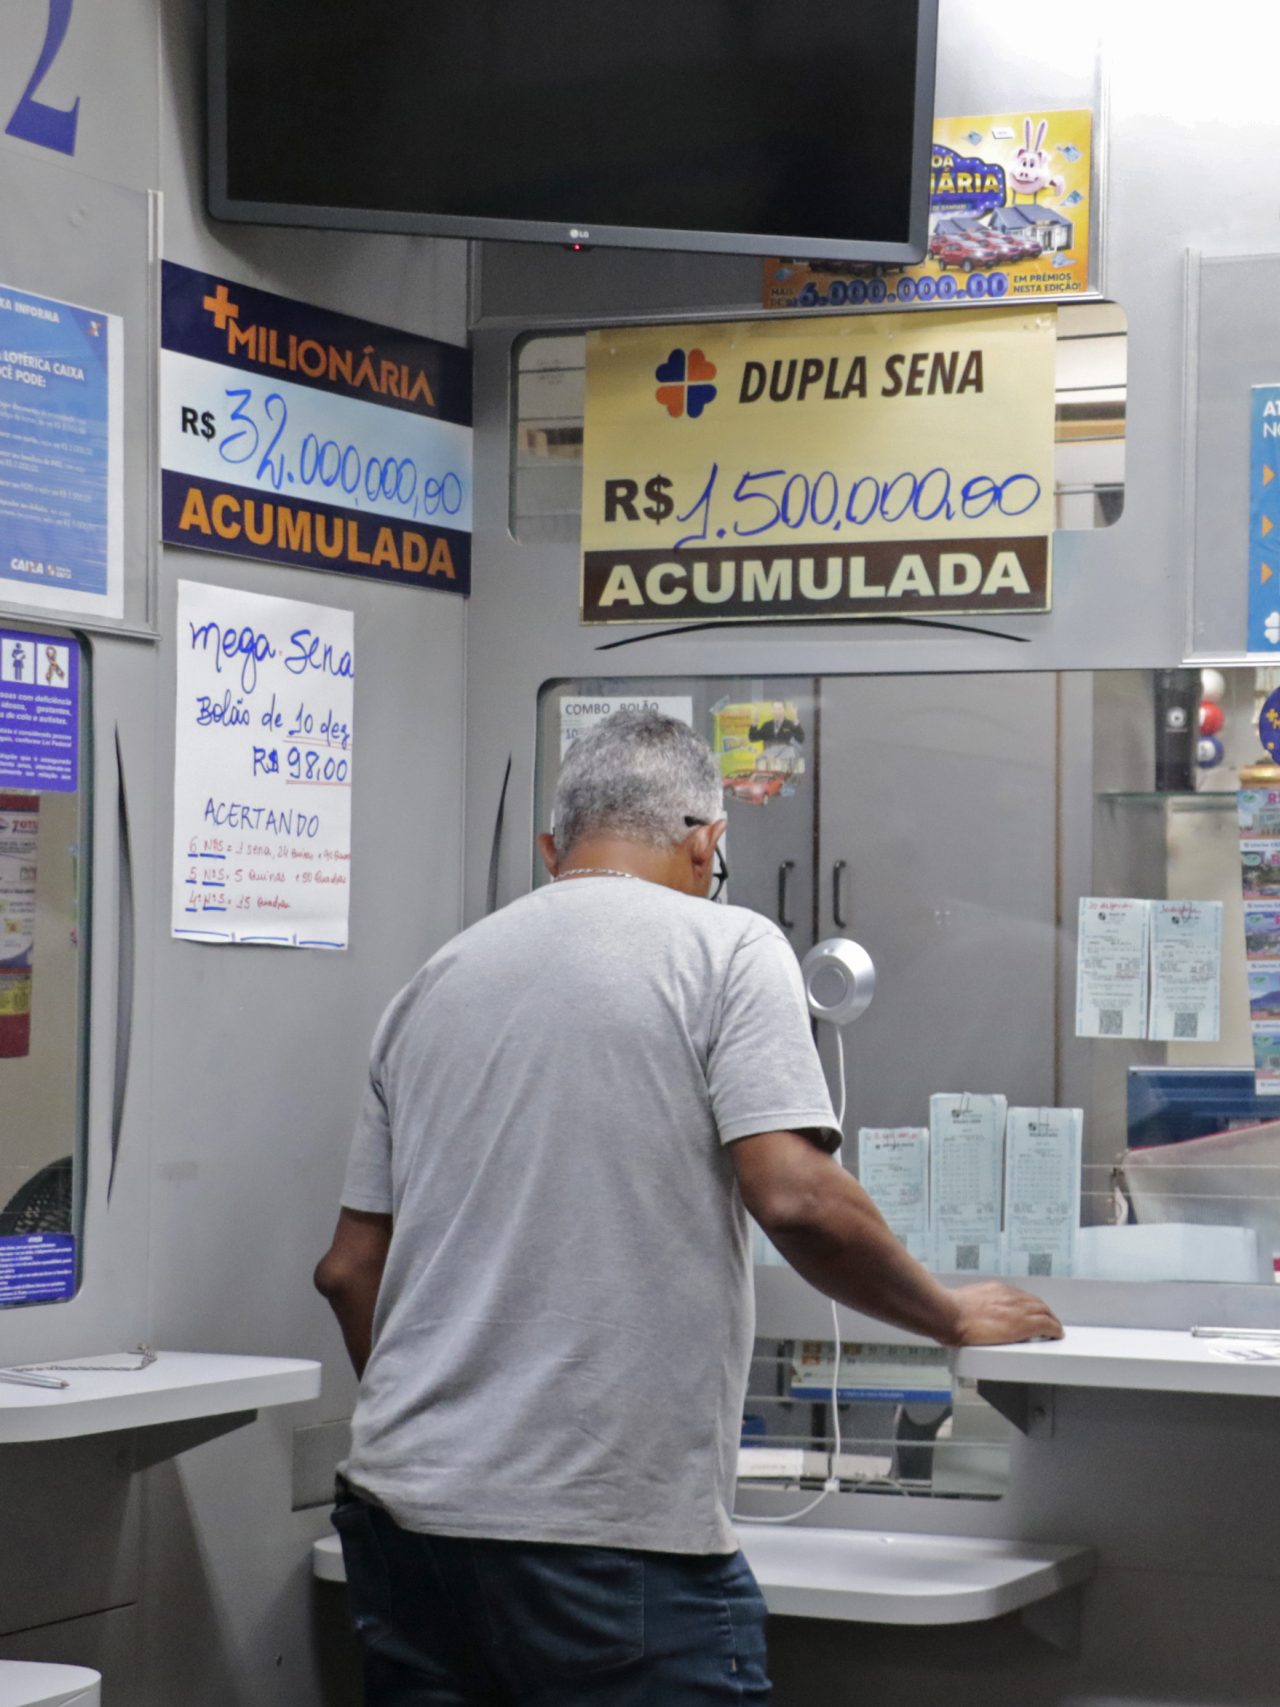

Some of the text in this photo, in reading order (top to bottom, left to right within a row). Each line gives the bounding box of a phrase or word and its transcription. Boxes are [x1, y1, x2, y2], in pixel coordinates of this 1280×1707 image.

[15, 301, 60, 323] INFORMA
[4, 351, 85, 381] LOTÉRICA CAIXA
[15, 369, 47, 387] PODE:
[738, 349, 984, 404] DUPLA SENA
[181, 406, 216, 442] R$
[604, 474, 674, 524] R$
[178, 487, 456, 579] ACUMULADA
[11, 557, 44, 575] CAIXA
[598, 551, 1030, 607] ACUMULADA
[262, 693, 283, 732] de
[565, 703, 611, 716] COMBO
[253, 746, 279, 776] R$
[205, 797, 319, 838] ACERTANDO
